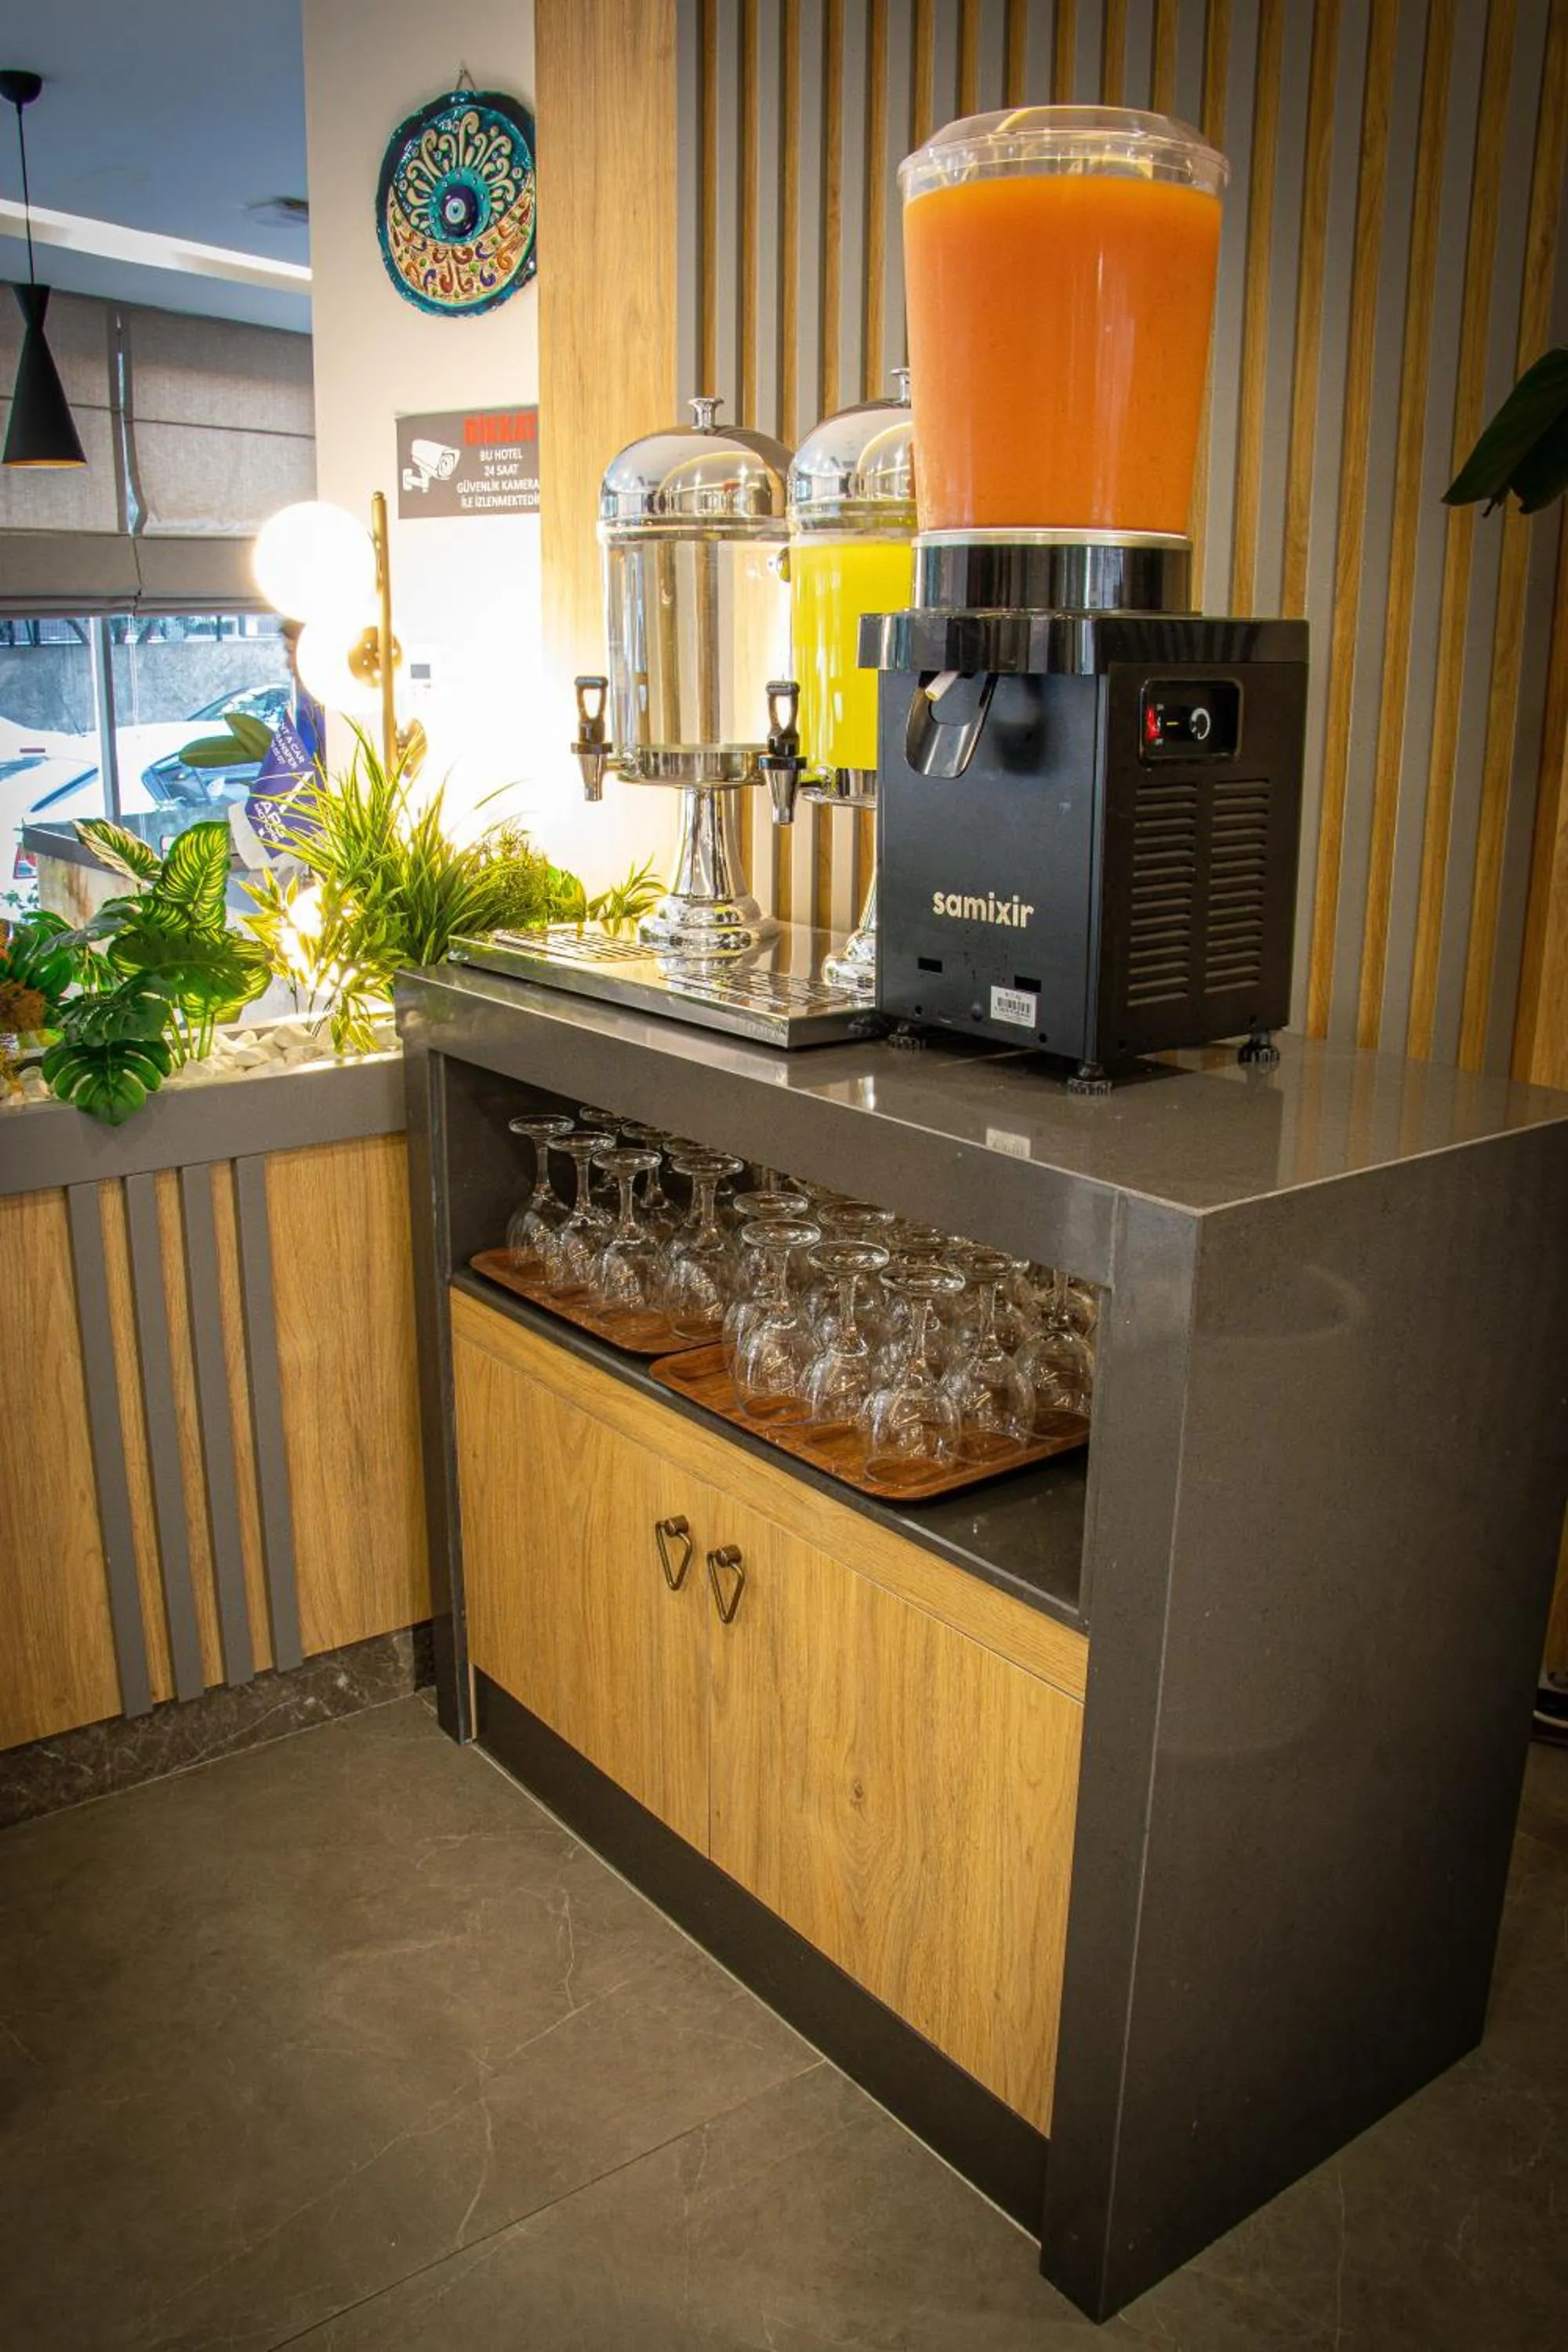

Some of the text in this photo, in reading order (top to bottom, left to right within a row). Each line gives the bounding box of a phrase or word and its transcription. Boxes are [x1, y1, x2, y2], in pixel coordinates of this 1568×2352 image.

[480, 448, 524, 462] BU HOTEL
[484, 463, 520, 477] 24 SAAT
[456, 479, 500, 494] GÜVENLİK
[932, 891, 1035, 928] samixir
